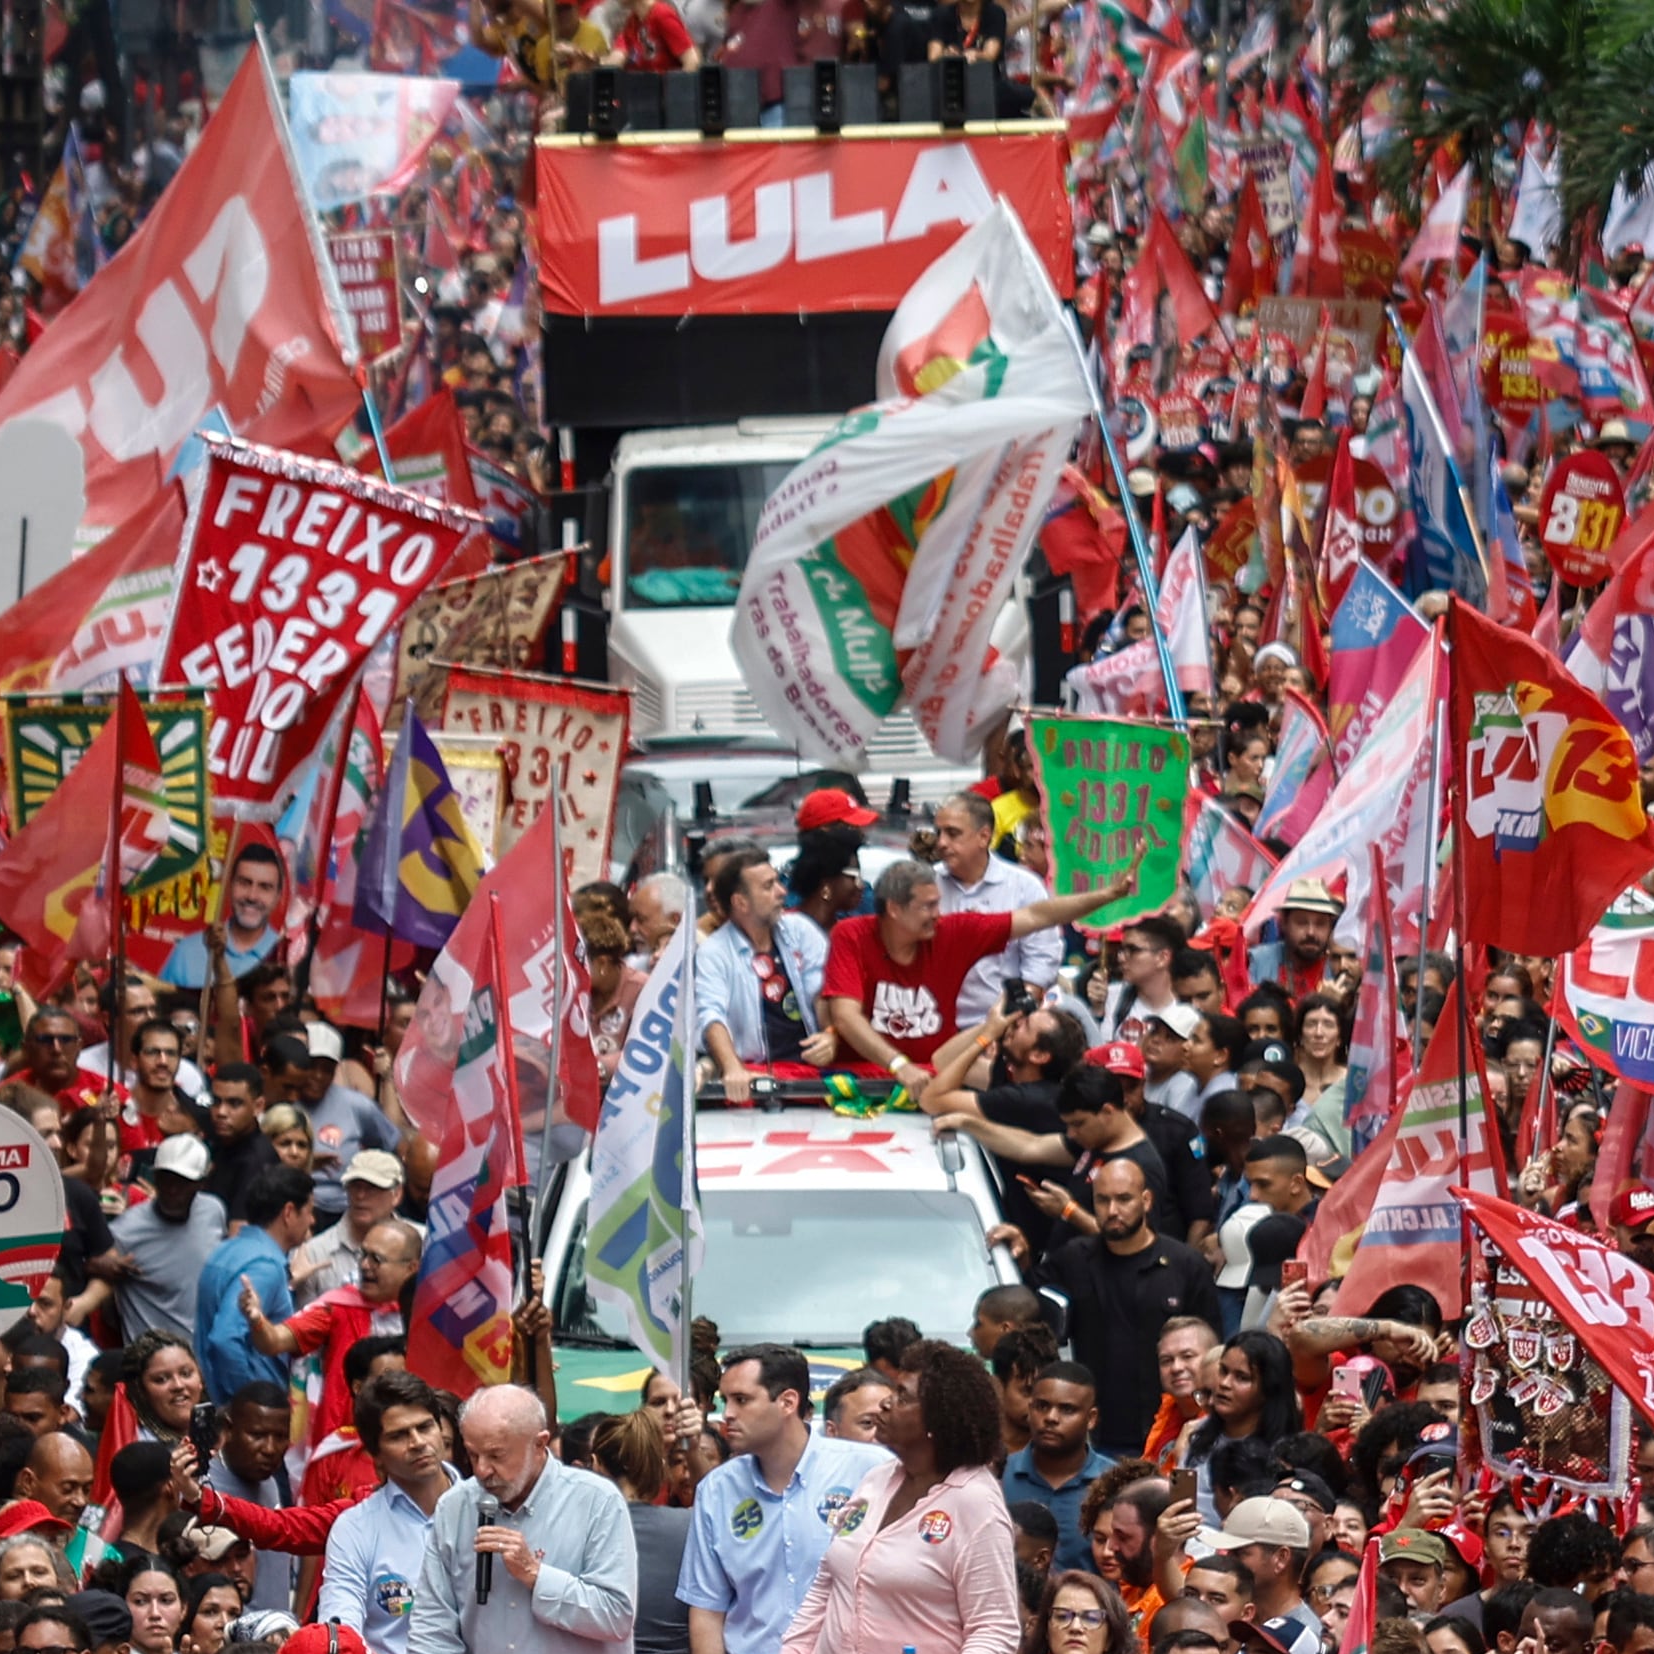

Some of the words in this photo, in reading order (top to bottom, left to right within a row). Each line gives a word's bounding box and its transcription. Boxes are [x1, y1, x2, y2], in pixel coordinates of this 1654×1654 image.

[598, 145, 996, 304] LULA
[212, 474, 436, 587] FREIXO
[1547, 491, 1578, 537] B
[226, 545, 398, 647] 1331
[468, 700, 593, 749] FREIXO
[1554, 728, 1634, 806] 13
[1075, 779, 1152, 822] 1331
[732, 1503, 764, 1535] 55
